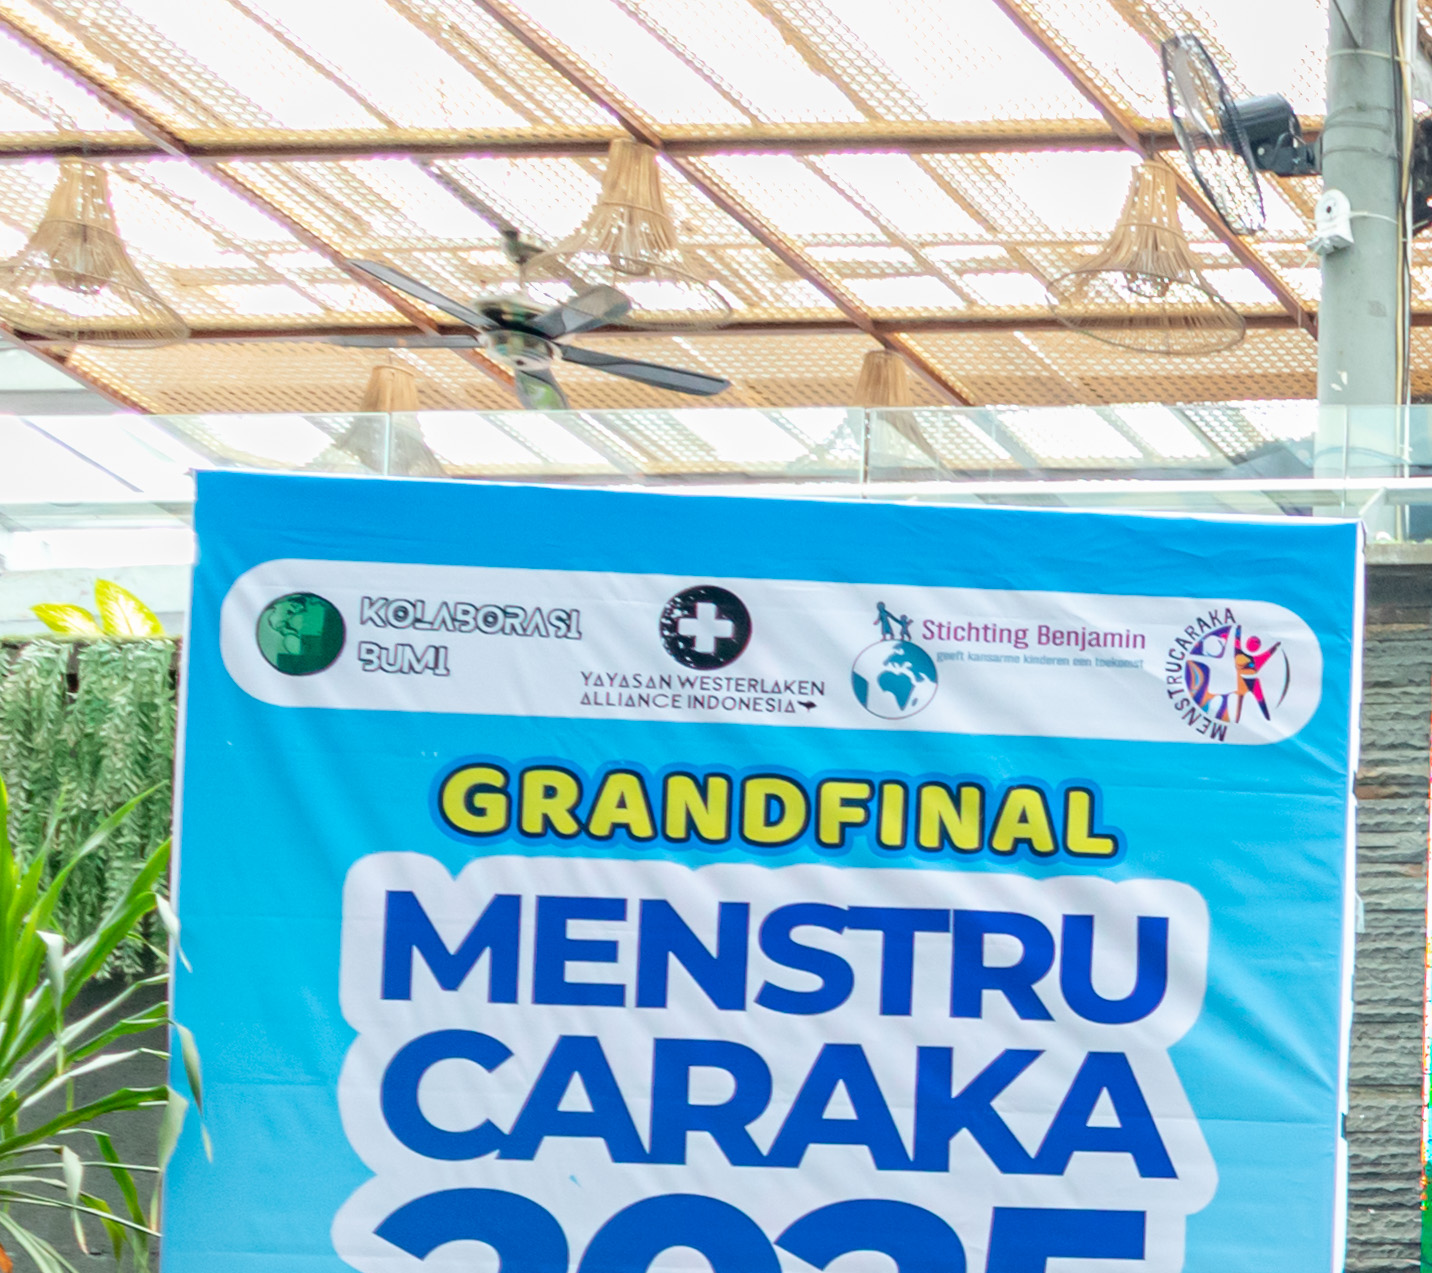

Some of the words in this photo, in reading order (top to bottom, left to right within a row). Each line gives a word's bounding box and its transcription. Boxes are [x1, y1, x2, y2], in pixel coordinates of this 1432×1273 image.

[360, 596, 582, 639] KOLABORASI
[922, 619, 1029, 649] Stichting
[1038, 625, 1146, 651] Benjamin
[358, 641, 450, 676] BUMI
[1165, 607, 1237, 742] MENSTRUCARAKA
[580, 671, 673, 690] YAYASAN
[677, 674, 825, 696] WESTERLAKEN
[580, 693, 682, 708] ALLIANCE
[688, 695, 796, 713] INDONESIA
[435, 761, 1120, 859] GRANDFINAL
[381, 889, 1170, 1025] MENSTRU
[378, 1029, 1177, 1179] CARAKA
